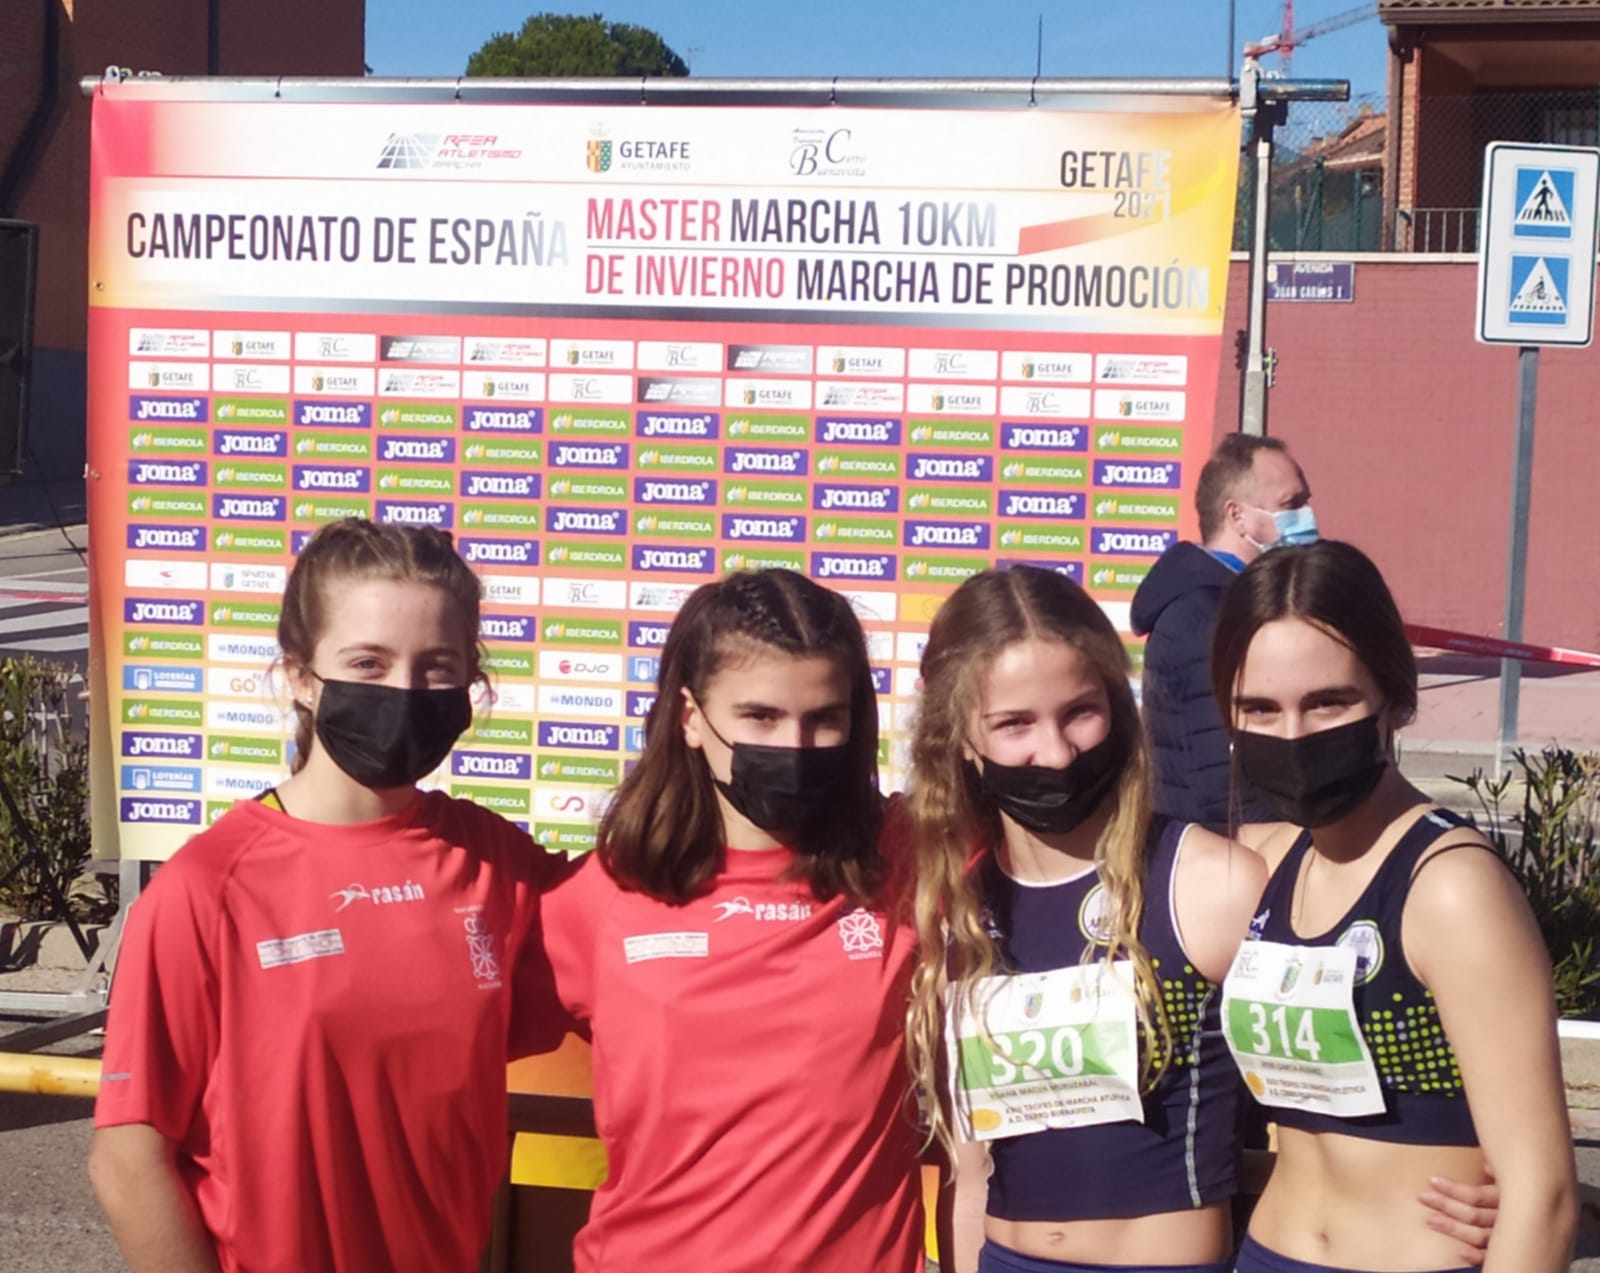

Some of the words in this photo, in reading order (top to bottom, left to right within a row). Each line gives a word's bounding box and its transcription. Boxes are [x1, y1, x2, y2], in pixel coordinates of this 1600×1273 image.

[437, 149, 523, 159] ATLETISMO
[620, 140, 690, 159] GETAFE
[621, 162, 691, 171] AYUNTAMIENTO
[1060, 150, 1172, 190] GETAFE
[587, 197, 721, 243] MASTER
[730, 199, 880, 245] MARCHA
[899, 201, 996, 248] 10KM
[128, 211, 361, 263] CAMPEONATO
[374, 216, 416, 264] DE
[430, 210, 569, 267] ESPAÑA
[586, 254, 624, 295] DE
[635, 255, 784, 298] INVIERNO
[797, 260, 939, 303] MARCHA
[953, 264, 993, 304] DE
[1006, 258, 1209, 311] PROMOCIÓN
[237, 408, 285, 418] IBERDROLA
[401, 413, 453, 423] IBERDROLA
[573, 419, 626, 429] IBERDROLA
[751, 424, 805, 435] IBERDROLA
[934, 430, 990, 441] IBERDROLA
[153, 437, 204, 447] IBERDROLA
[1121, 436, 1178, 447] IBERDROLA
[316, 443, 367, 453] IBERDROLA
[487, 449, 539, 459] IBERDROLA
[660, 454, 713, 464] IBERDROLA
[840, 460, 895, 471] IBERDROLA
[236, 473, 283, 482] IBERDROLA
[1026, 467, 1082, 478] IBERDROLA
[399, 479, 450, 489] IBERDROLA
[571, 485, 624, 495] IBERDROLA
[748, 491, 802, 501] IBERDROLA
[152, 501, 203, 510] IBERDROLA
[931, 498, 987, 509] IBERDROLA
[1119, 505, 1175, 515] IBERDROLA
[484, 514, 536, 524] IBERDROLA
[658, 521, 711, 531] IBERDROLA
[838, 528, 893, 538] IBERDROLA
[235, 538, 282, 548] IBERDROLA
[1023, 535, 1080, 545] IBERDROLA
[569, 552, 622, 562] IBERDROLA
[566, 628, 618, 638] IBERDROLA
[151, 641, 201, 651] IBERDROLA
[228, 644, 274, 656] MONDO
[560, 695, 613, 707] MONDO
[149, 708, 200, 718] IBERDROLA
[226, 712, 272, 724] MONDO
[231, 746, 277, 757] IBERDROLA
[562, 767, 614, 777] IBERDROLA
[1250, 1003, 1320, 1061] 314
[991, 1027, 1084, 1086] 320
